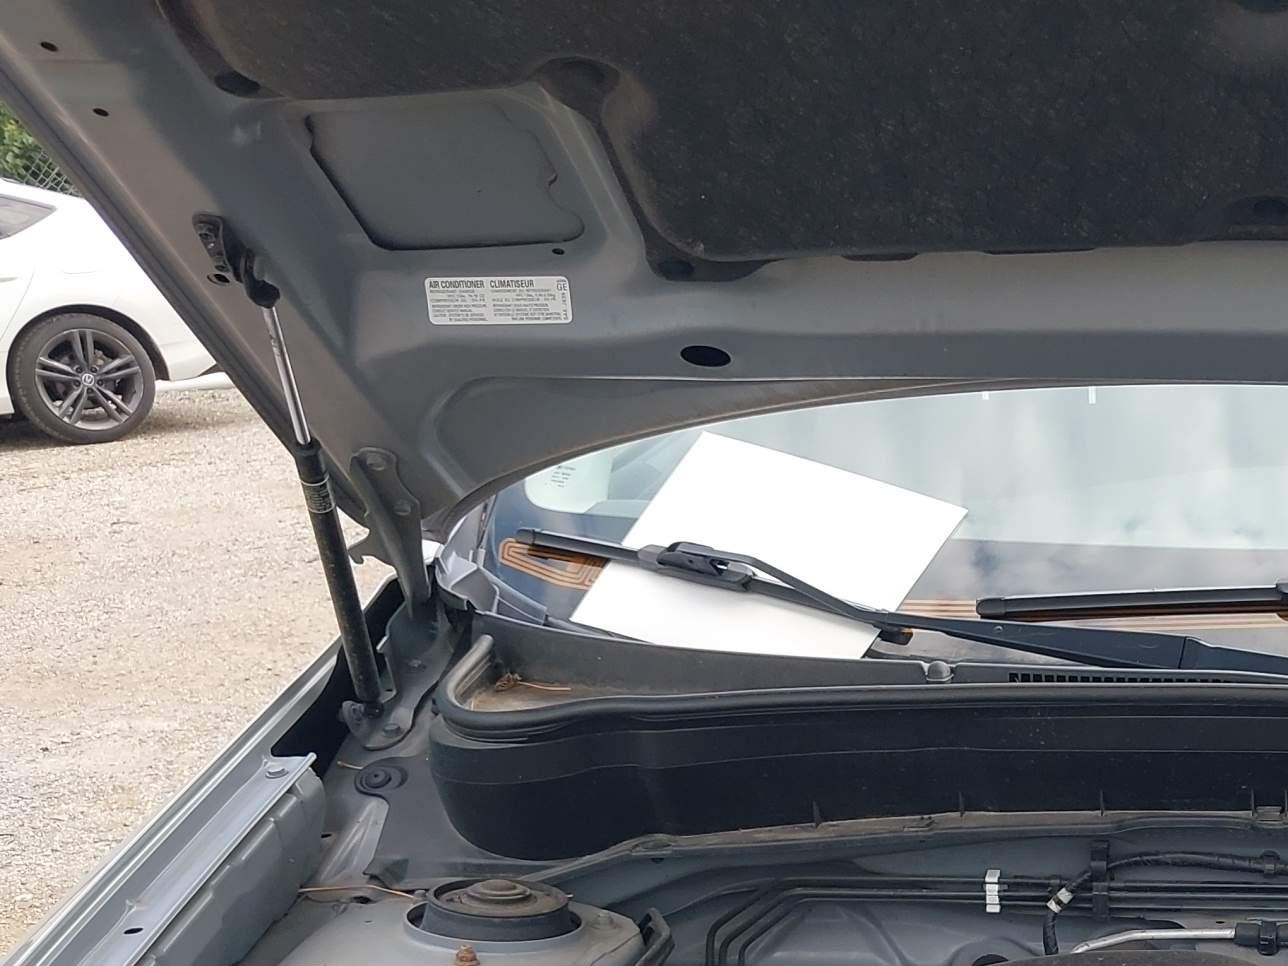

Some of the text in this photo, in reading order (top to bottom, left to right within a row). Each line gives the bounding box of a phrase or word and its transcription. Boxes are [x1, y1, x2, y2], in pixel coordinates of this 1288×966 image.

[429, 279, 534, 288] AIR CONDITIONER CLIMATISEUR
